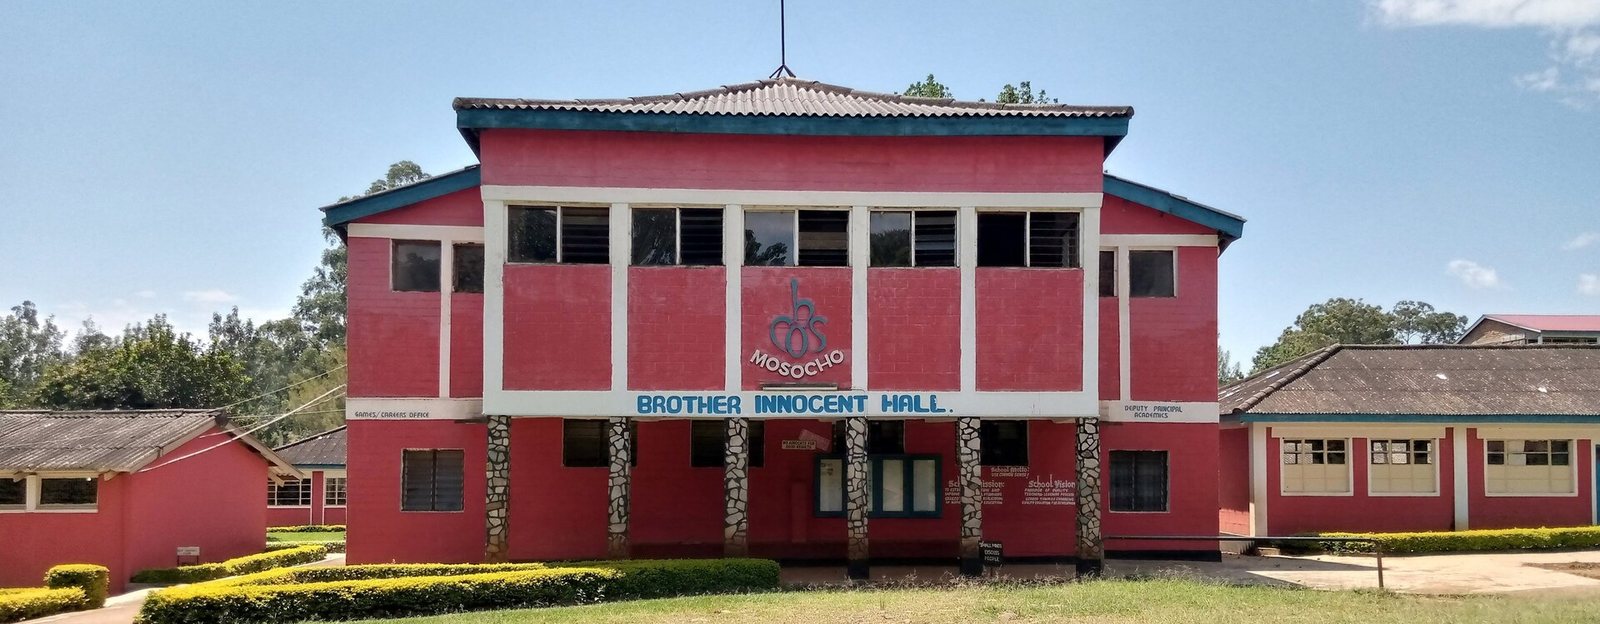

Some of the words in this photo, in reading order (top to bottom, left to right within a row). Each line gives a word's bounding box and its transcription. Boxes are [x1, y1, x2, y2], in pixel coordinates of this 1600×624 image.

[750, 349, 845, 379] MOSOCHO
[637, 394, 741, 415] BROTHER
[755, 394, 868, 414] INNOCENT
[881, 394, 954, 414] HALL.
[1153, 405, 1183, 413] PRINCIPAL
[1028, 474, 1053, 490] School
[1053, 480, 1076, 489] Vision
